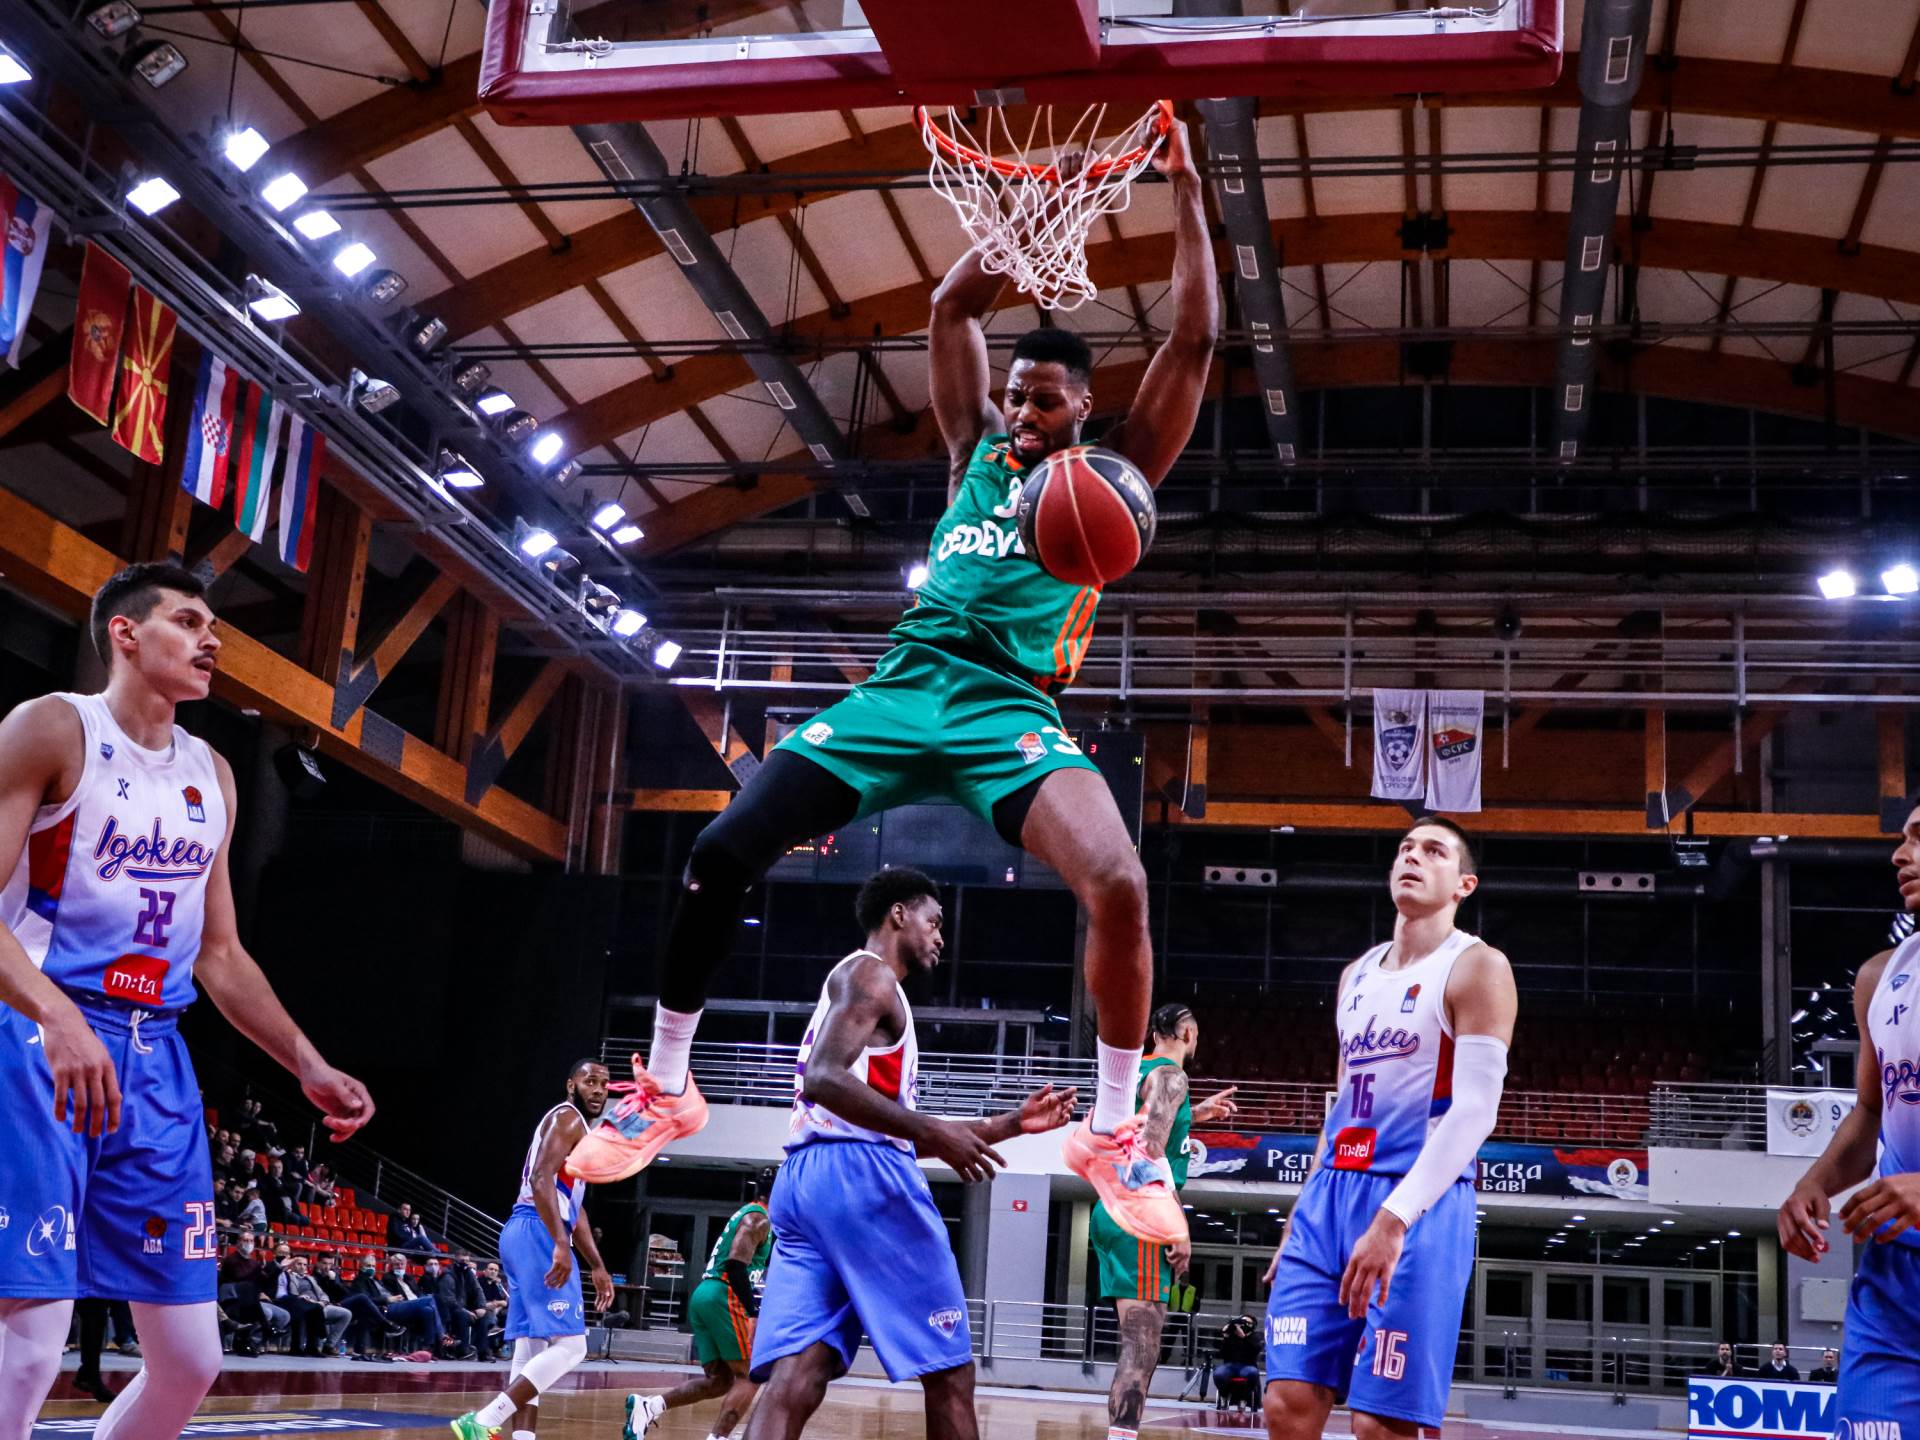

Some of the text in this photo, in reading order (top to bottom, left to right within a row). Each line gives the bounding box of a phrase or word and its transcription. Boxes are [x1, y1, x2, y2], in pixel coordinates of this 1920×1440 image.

[1041, 726, 1082, 756] 3
[1089, 744, 1098, 754] 3
[94, 816, 214, 882] Igokea
[827, 835, 835, 845] 2
[820, 845, 829, 856] 4
[132, 887, 177, 949] 22
[1350, 1073, 1376, 1119] 16
[1339, 1139, 1371, 1158] m:tel
[142, 1238, 164, 1255] ABA
[1273, 1317, 1308, 1332] NOVA
[1372, 1329, 1408, 1381] 16
[1852, 1421, 1903, 1440] NOVA
